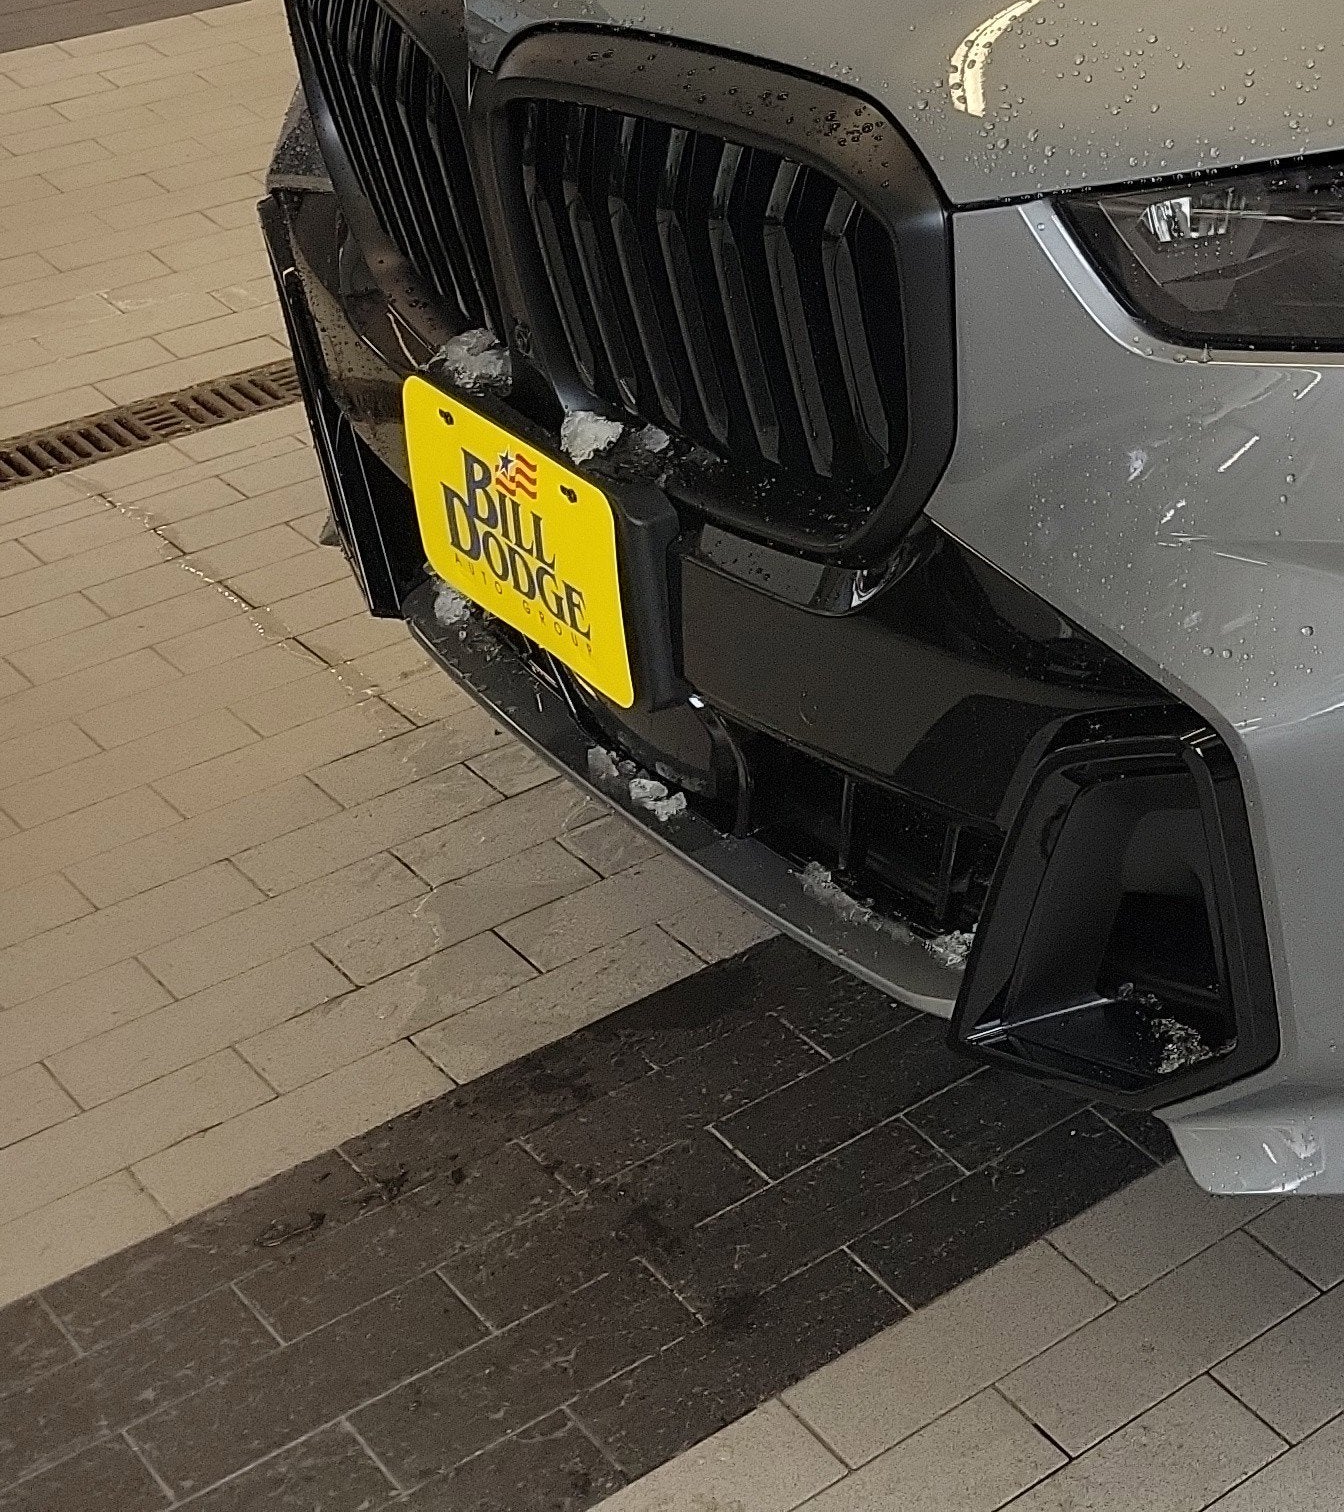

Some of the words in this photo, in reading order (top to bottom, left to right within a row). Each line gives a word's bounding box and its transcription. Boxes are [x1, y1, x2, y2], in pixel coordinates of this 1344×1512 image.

[440, 481, 592, 642] DODGE
[460, 446, 556, 570] BILL
[454, 552, 503, 595] AUTO
[522, 599, 593, 657] GROUP
